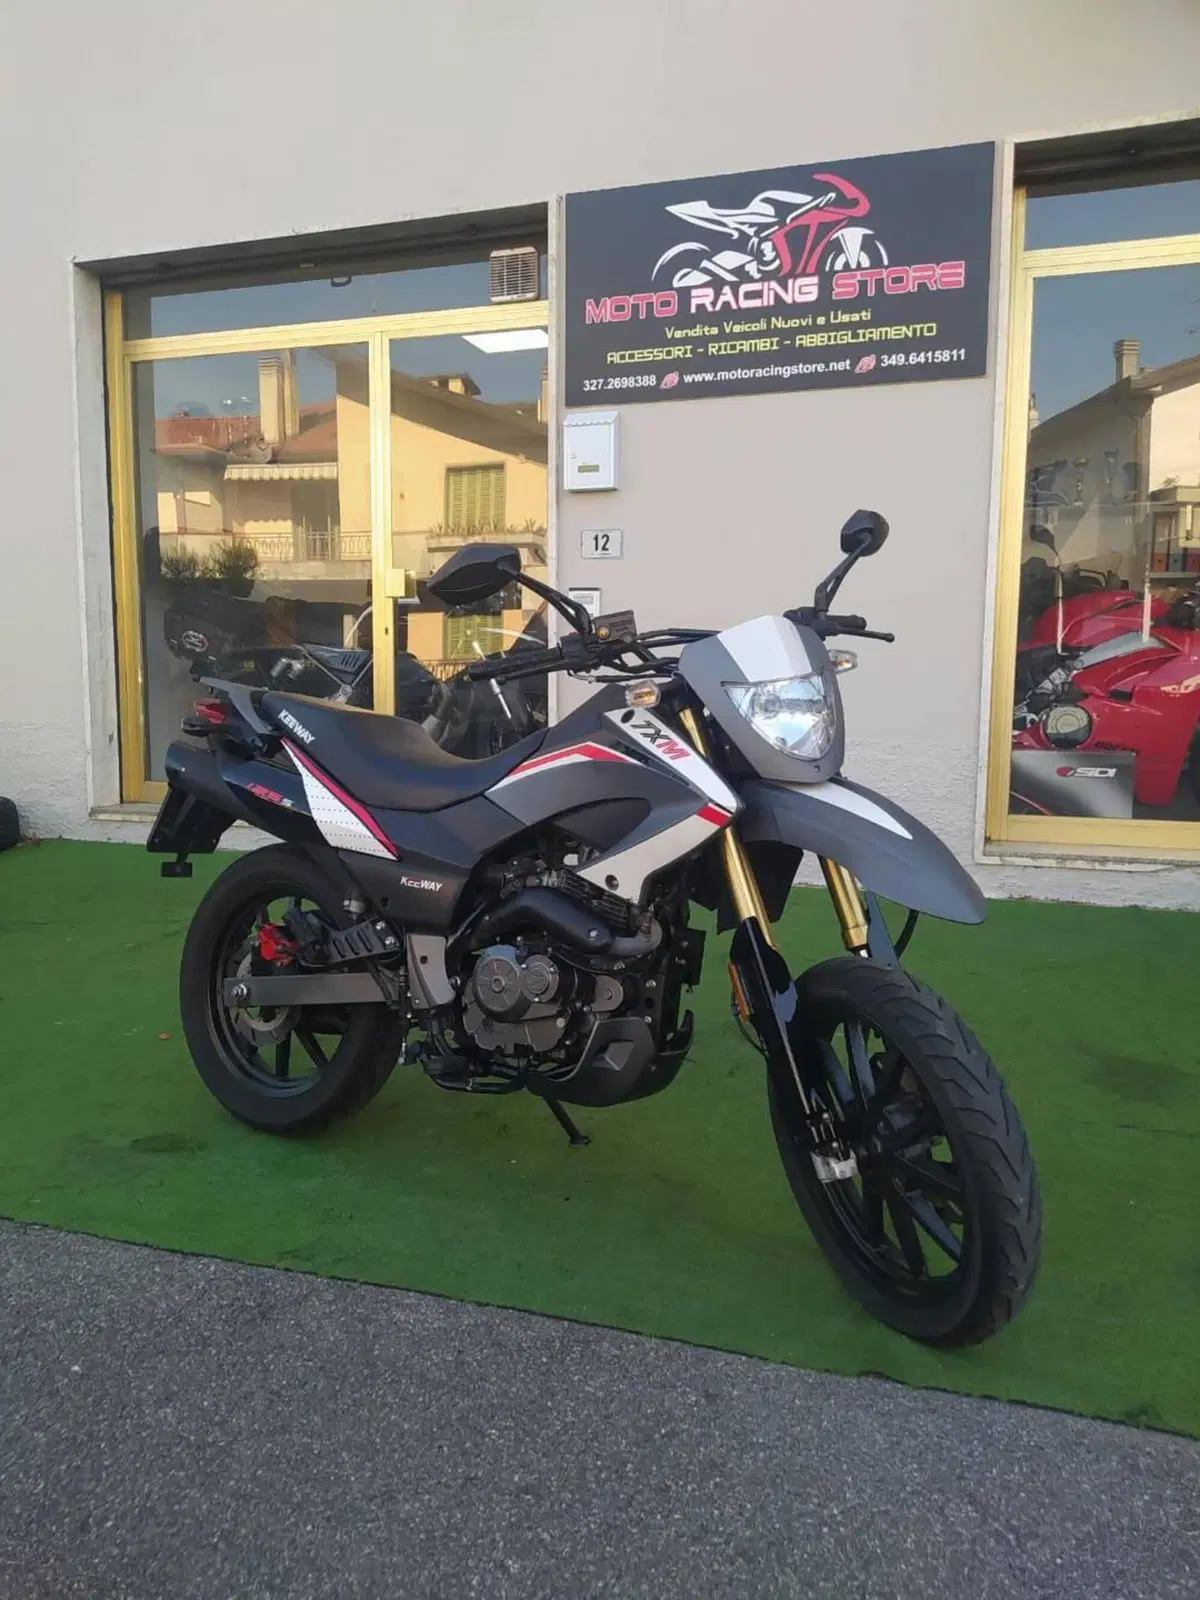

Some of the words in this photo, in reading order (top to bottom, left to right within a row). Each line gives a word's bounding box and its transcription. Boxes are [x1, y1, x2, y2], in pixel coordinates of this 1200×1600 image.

[585, 290, 678, 324] MOTO
[690, 275, 819, 314] RACING
[832, 260, 966, 300] STORE
[665, 324, 719, 339] Vendita
[723, 318, 767, 334] Veicoli
[771, 314, 812, 329] Nuovi
[816, 315, 826, 325] e
[830, 308, 871, 324] Usati
[607, 345, 693, 364] ACCESSORI
[708, 337, 780, 356] RICAMBI
[795, 323, 937, 348] ABBIGLIAMENTO
[583, 374, 657, 391] 327.2698388
[683, 358, 851, 383] www.motoracingstore.net
[880, 348, 966, 368] 349.6415811
[593, 534, 610, 552] 12
[278, 708, 316, 744] KEEWAY
